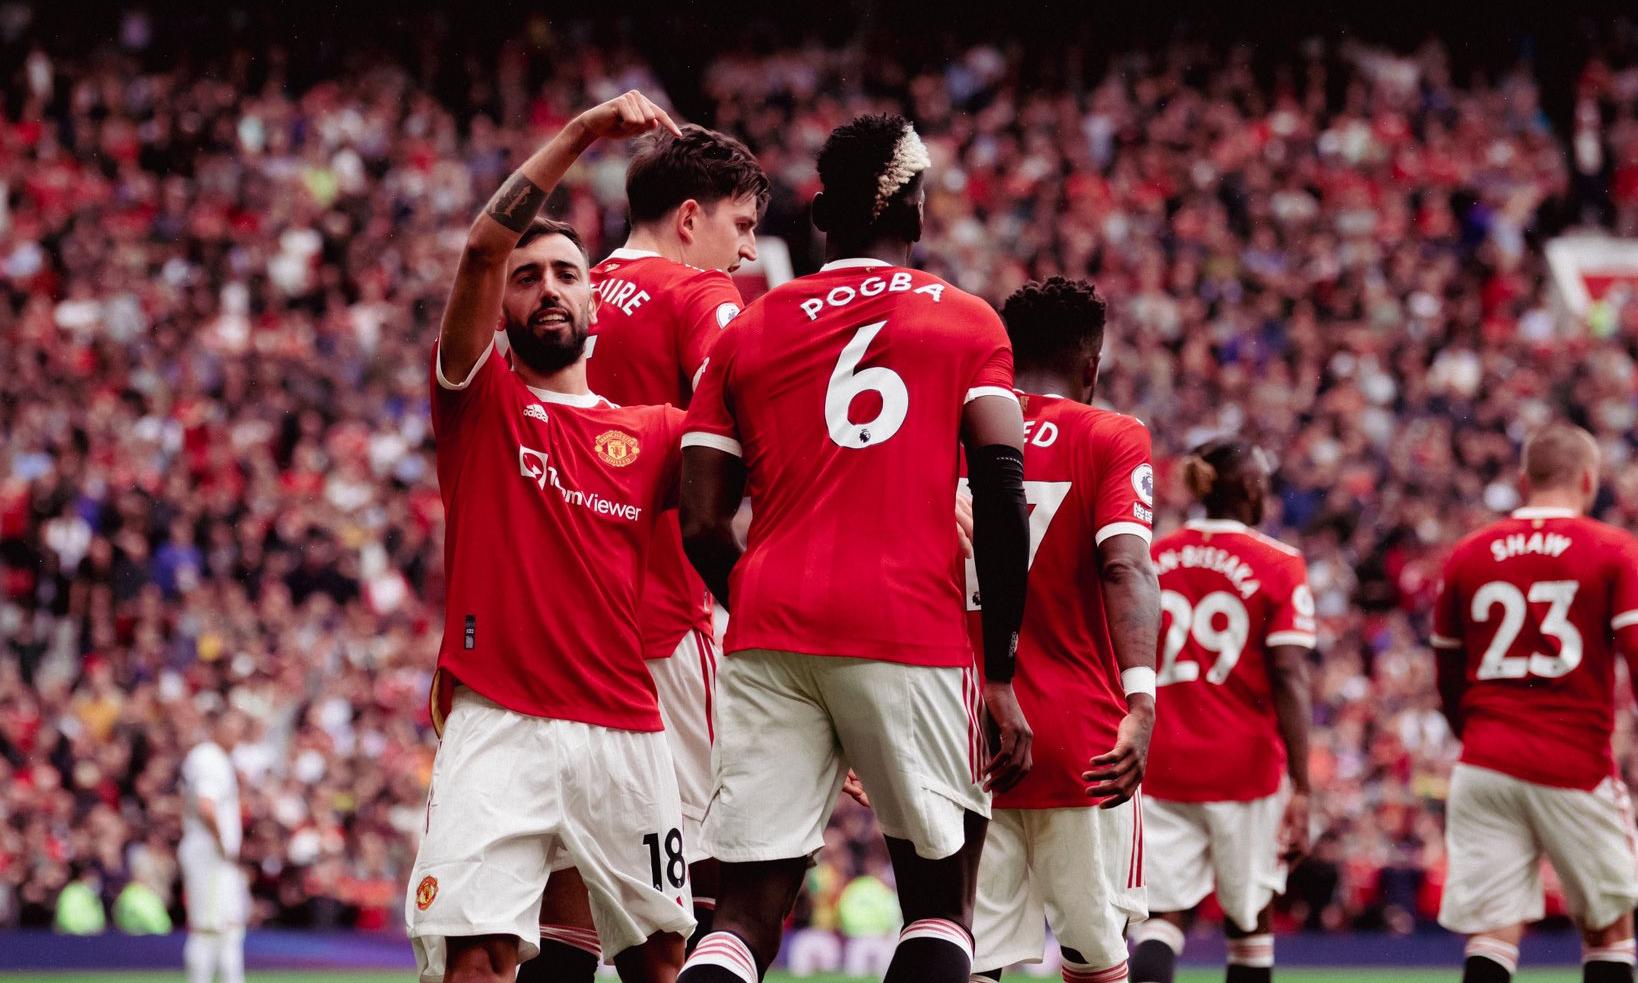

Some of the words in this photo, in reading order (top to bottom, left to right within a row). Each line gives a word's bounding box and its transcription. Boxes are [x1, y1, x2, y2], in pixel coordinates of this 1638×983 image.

[590, 278, 651, 316] UIRE
[800, 272, 945, 321] POGBA
[825, 320, 909, 449] 6
[1023, 420, 1059, 448] ED
[1490, 531, 1573, 562] SHAW
[1156, 589, 1249, 685] 29
[1471, 579, 1584, 680] 23
[643, 828, 686, 892] 18
